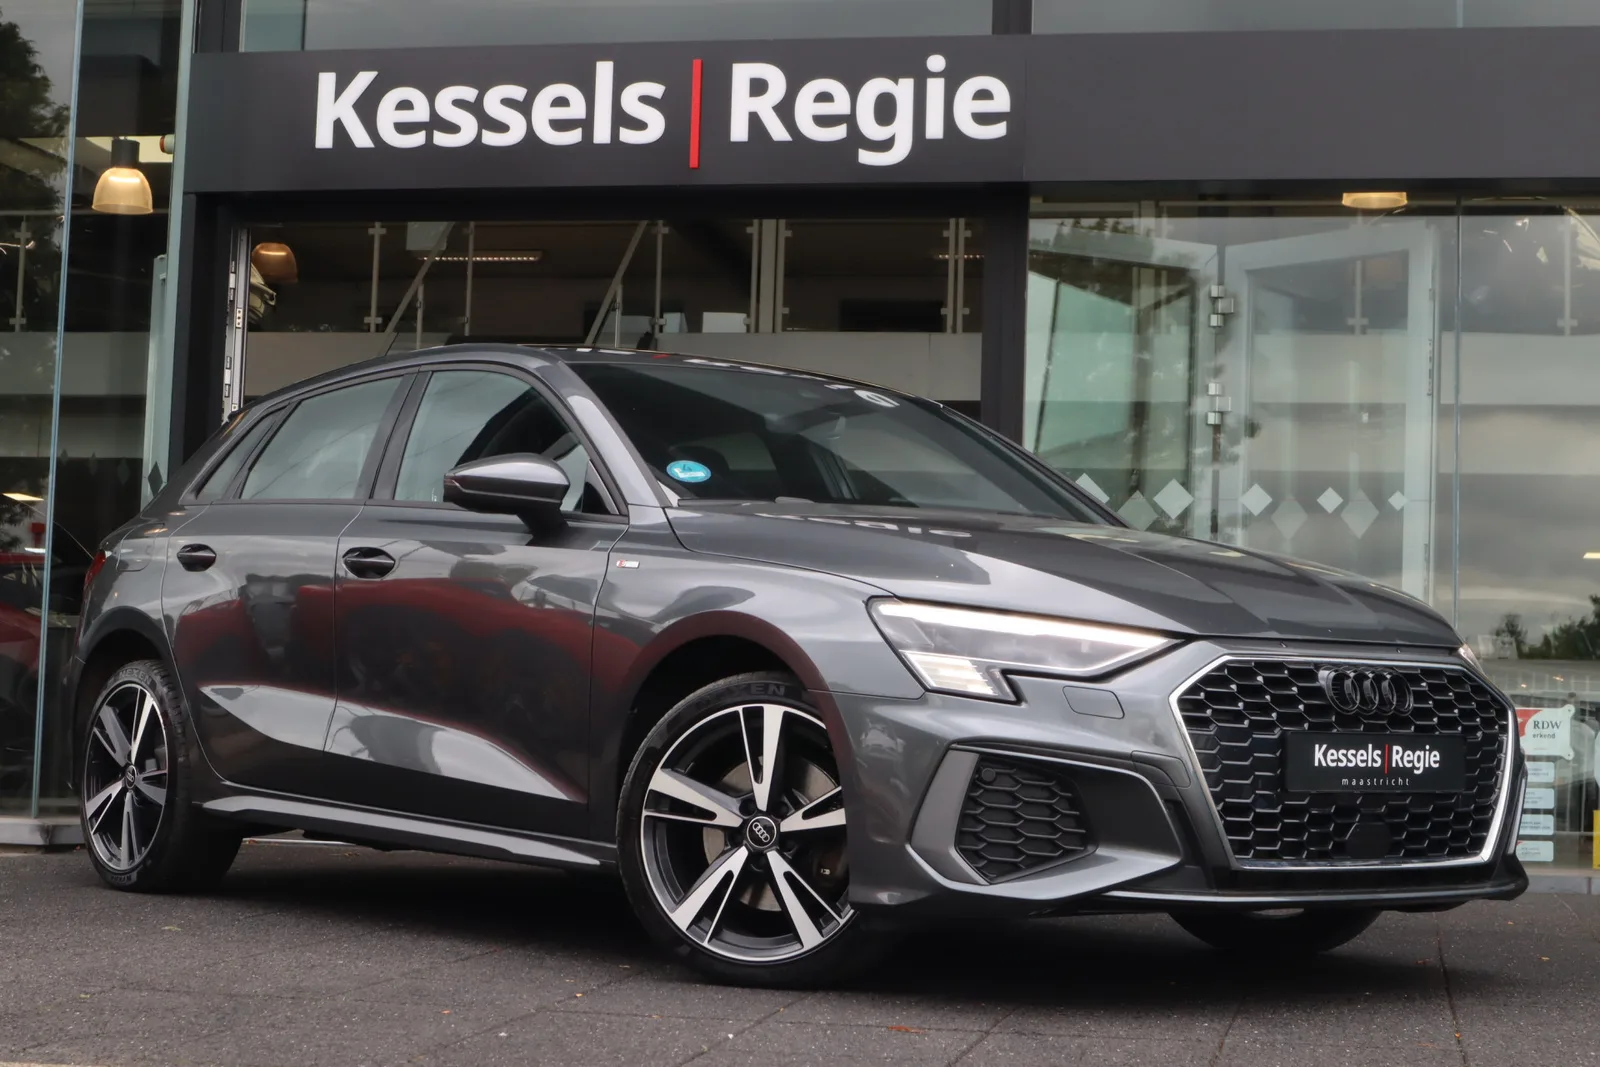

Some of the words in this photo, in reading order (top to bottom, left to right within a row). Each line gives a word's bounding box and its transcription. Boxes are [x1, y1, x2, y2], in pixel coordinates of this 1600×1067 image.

[315, 61, 666, 149] Kessels
[730, 55, 1011, 166] Regie
[1532, 720, 1562, 730] RDW
[1314, 743, 1382, 768] Kessels
[1391, 744, 1440, 775] Regie
[1341, 777, 1409, 786] maastricht
